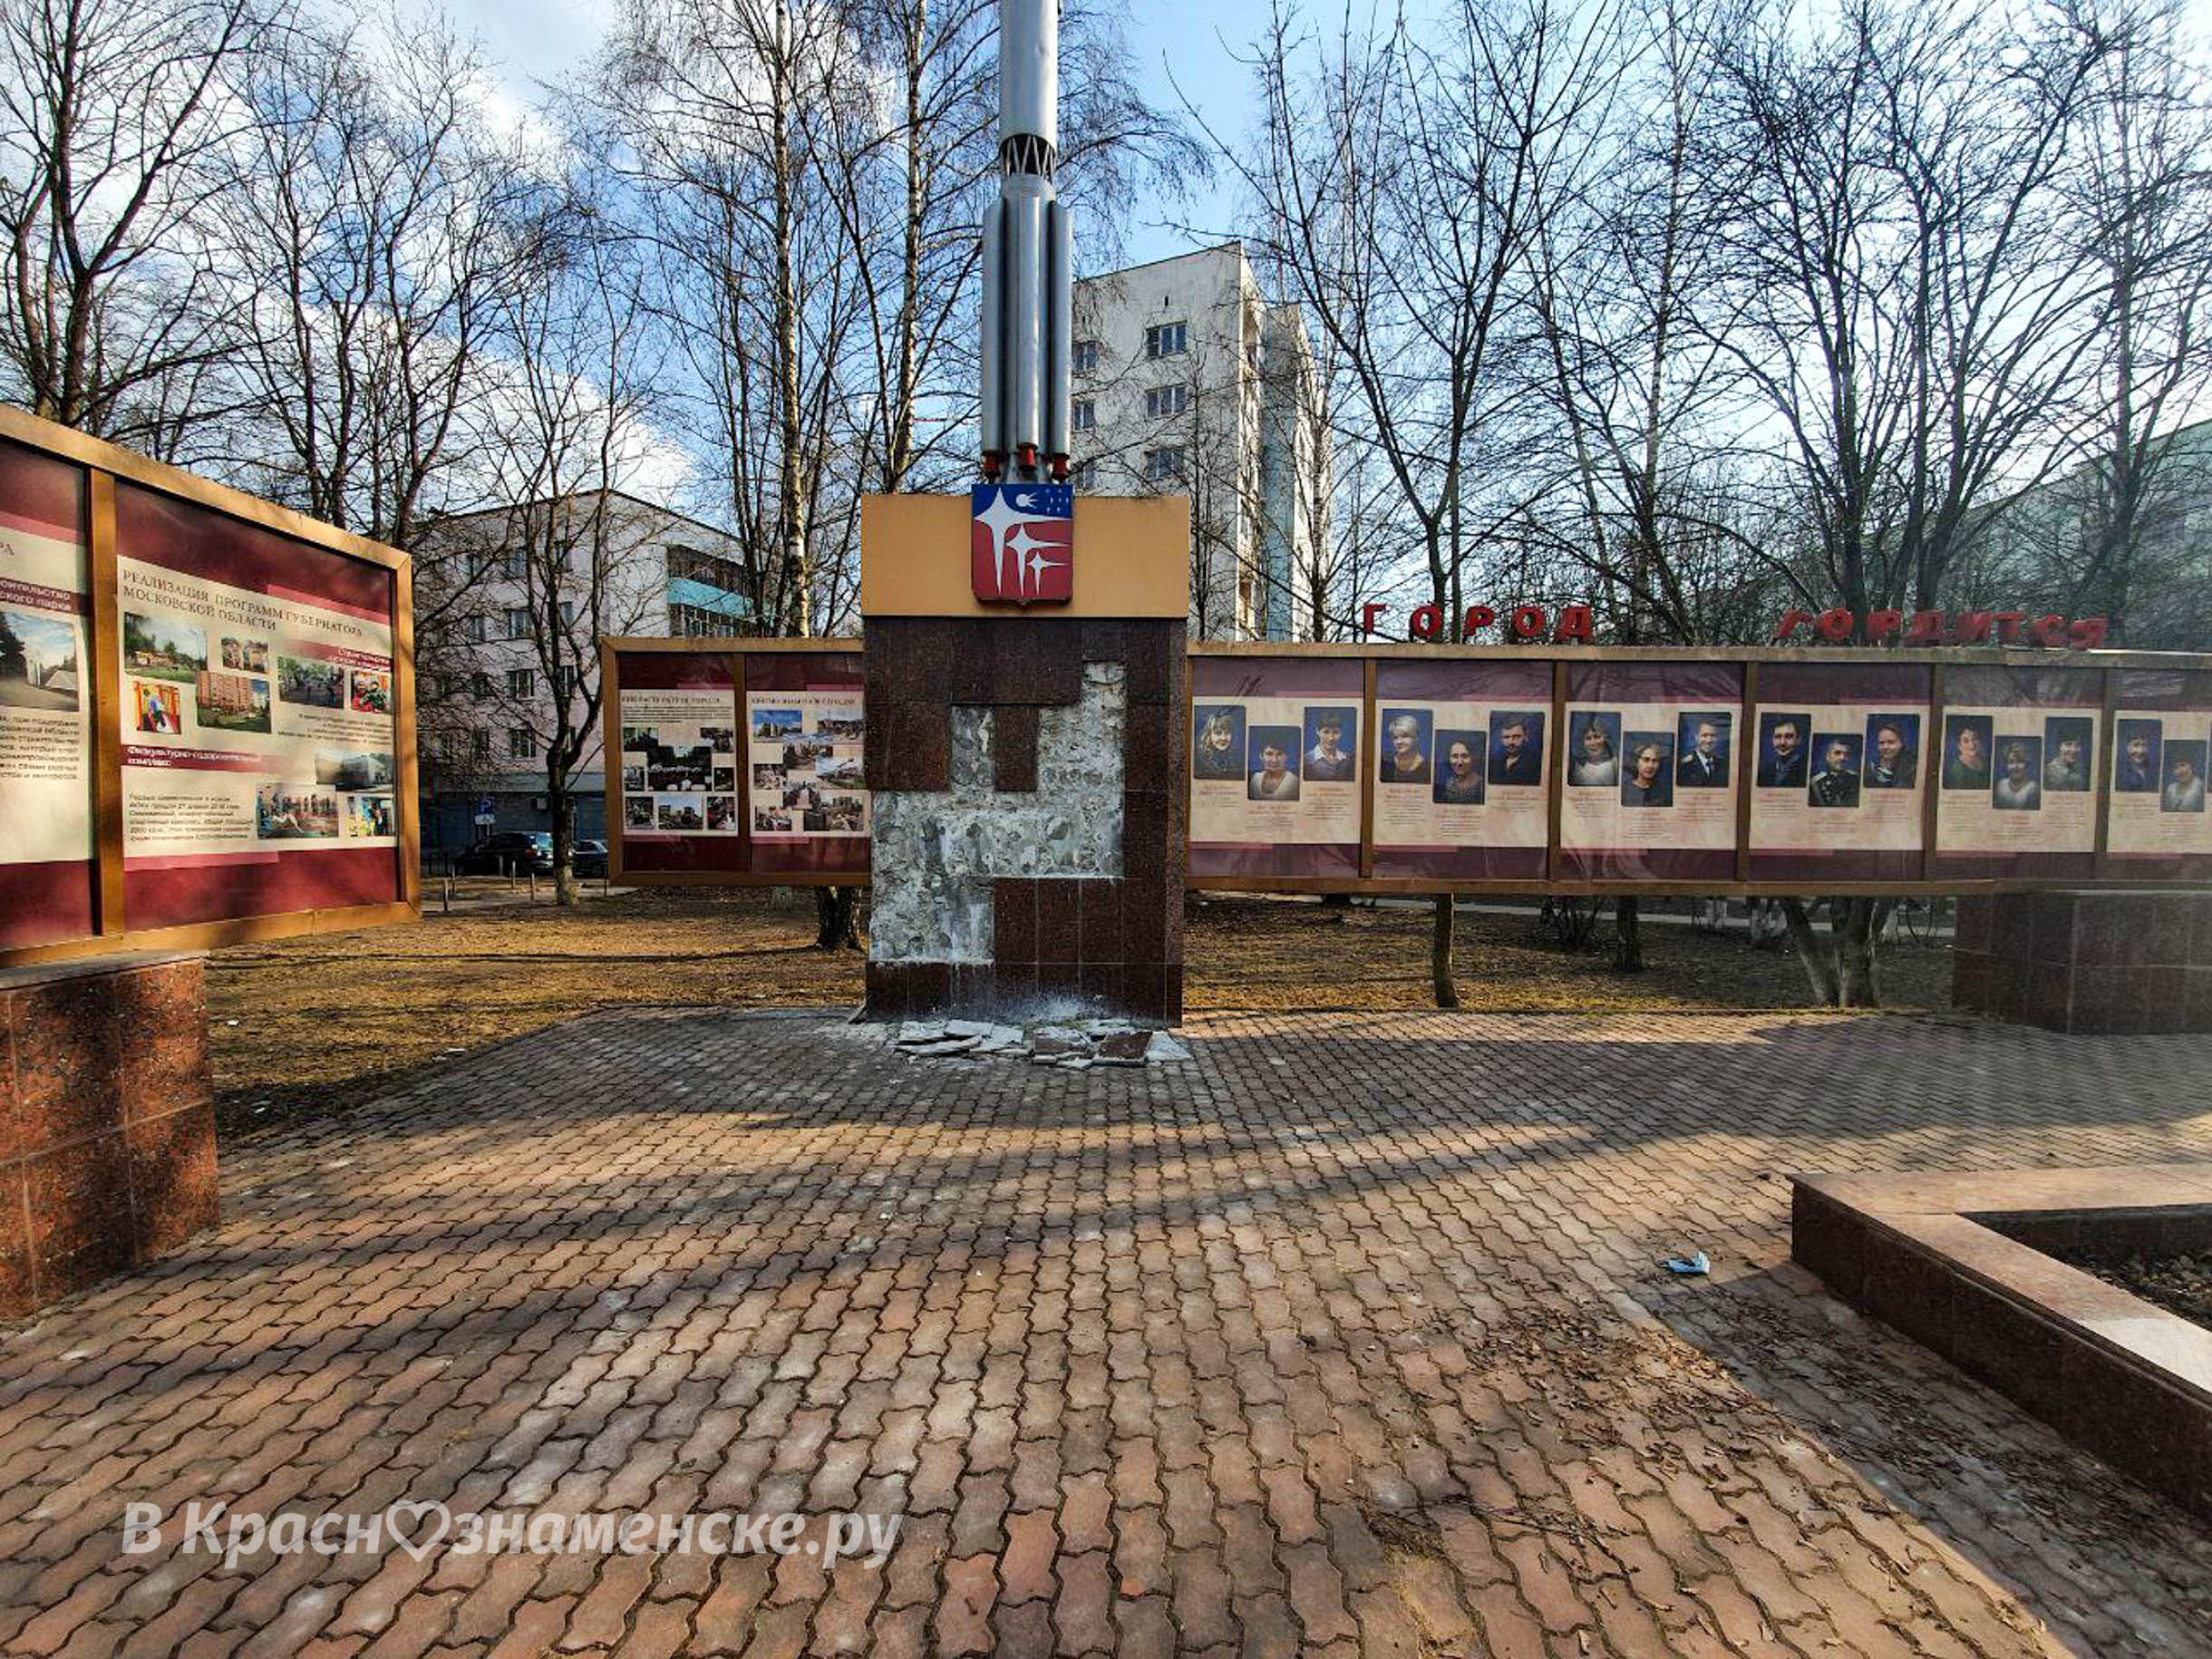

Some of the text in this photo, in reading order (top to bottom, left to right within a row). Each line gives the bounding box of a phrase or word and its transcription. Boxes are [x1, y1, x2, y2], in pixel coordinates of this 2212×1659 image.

[123, 570, 362, 637] РЕАЛИЗАЦИЯ ПРОГРАММ ГУБЕРНАТОРА
[123, 586, 276, 632] МОСКОВСКОЙ ОБЛАСТИ
[1363, 604, 2108, 649] ГОРОД ГОРДИТСЯ
